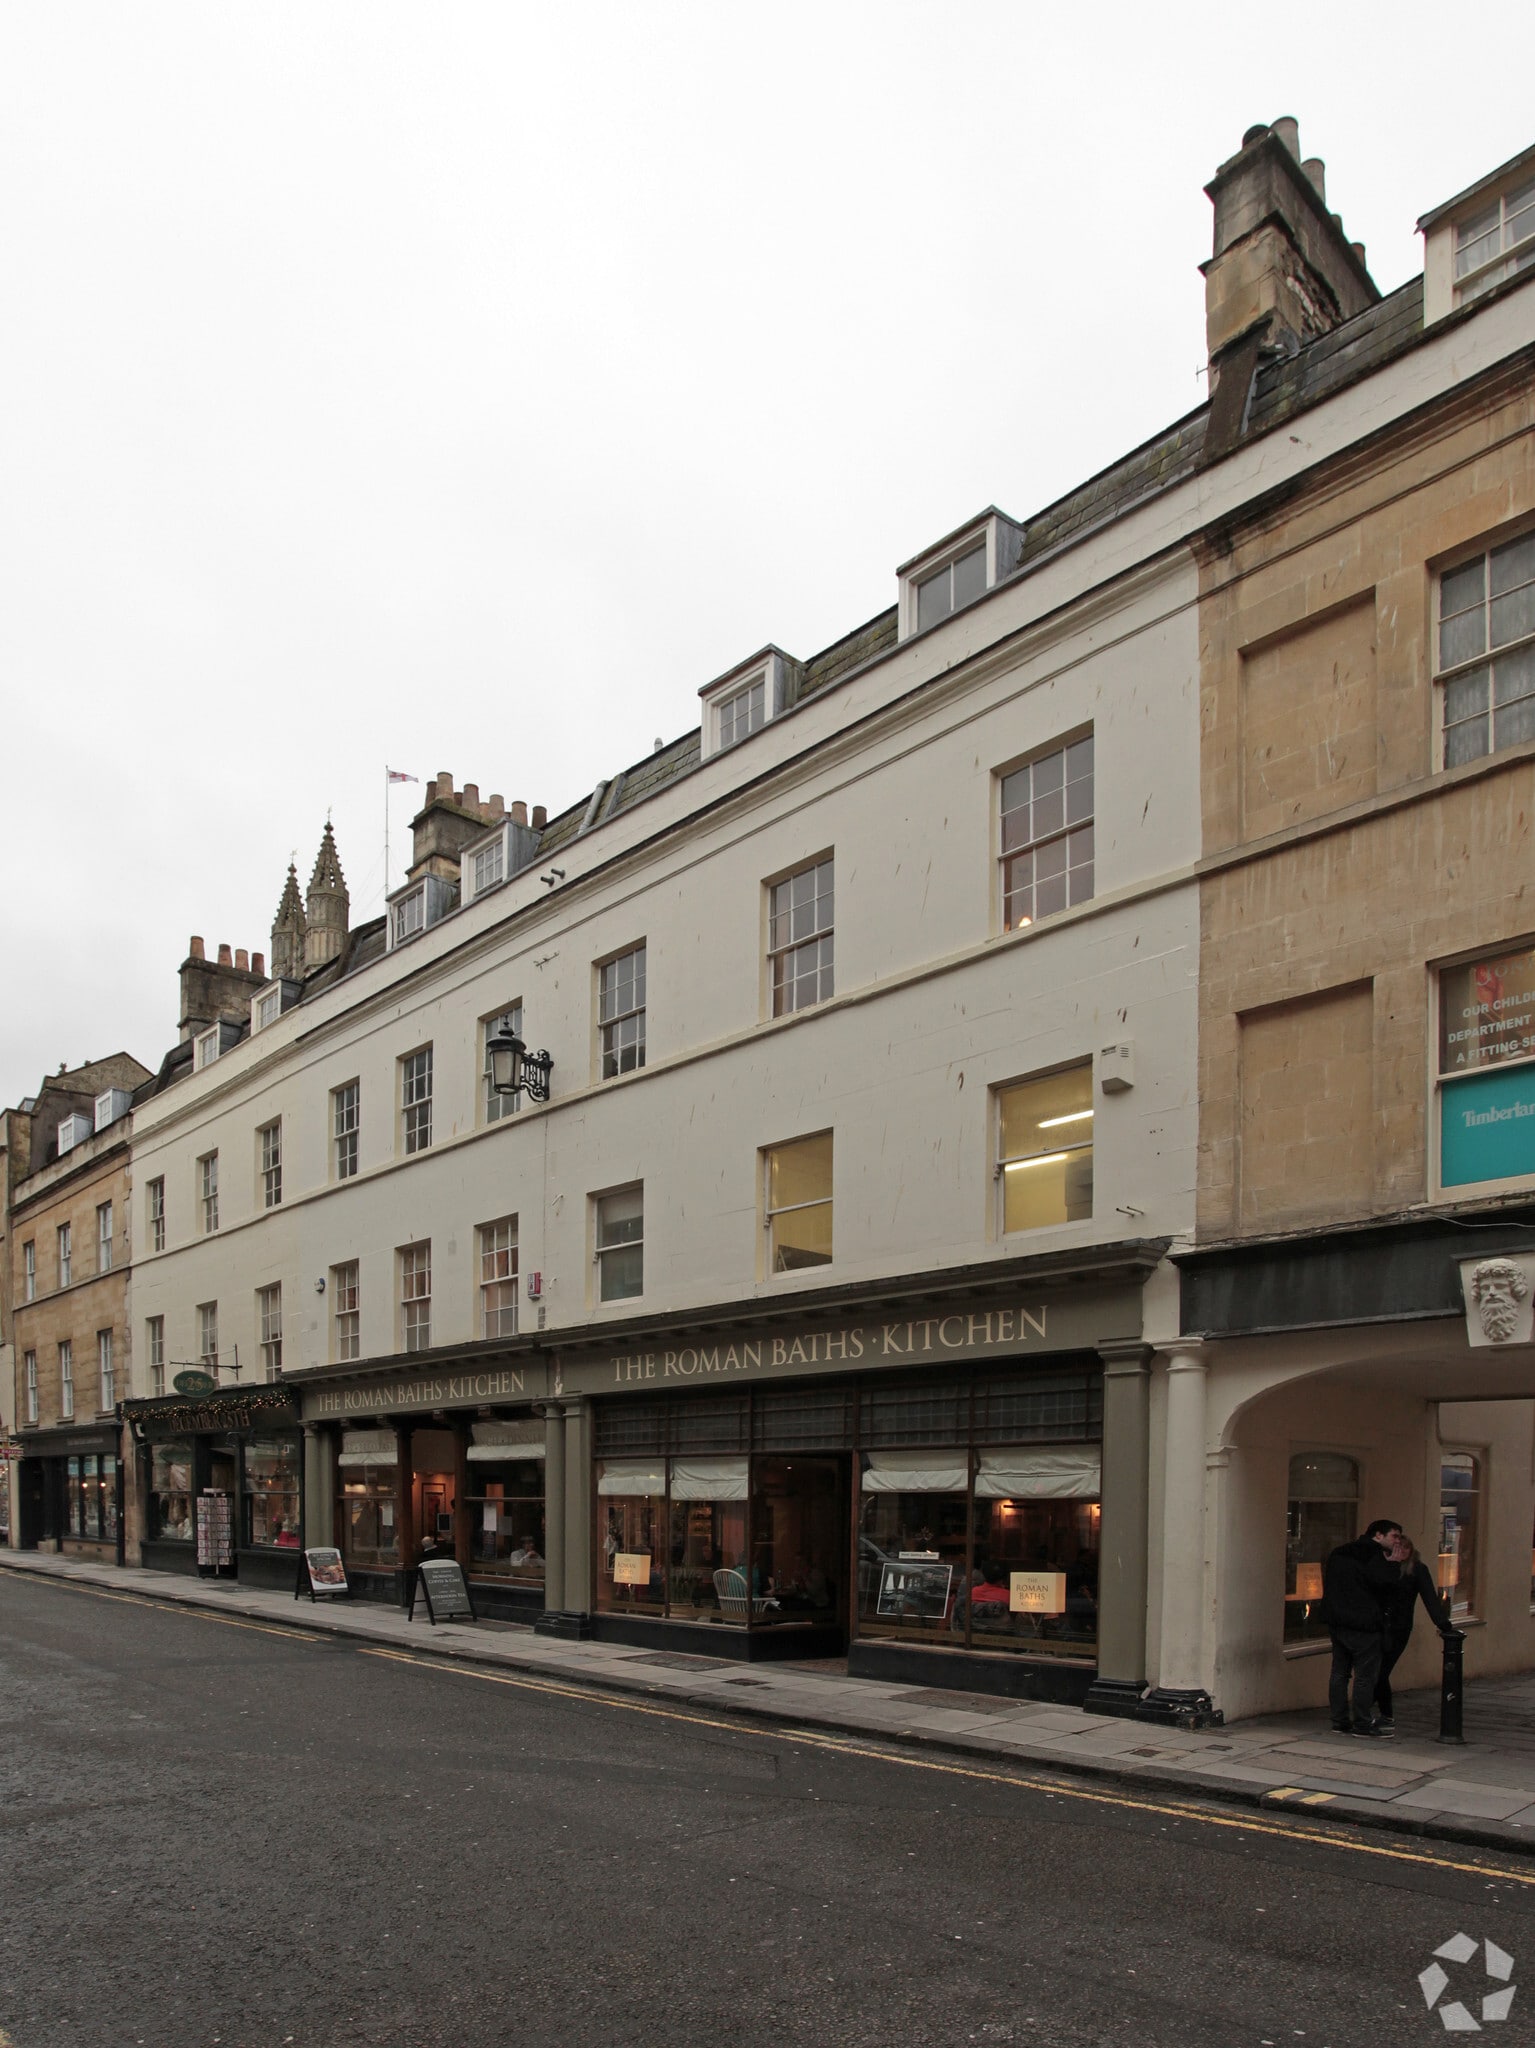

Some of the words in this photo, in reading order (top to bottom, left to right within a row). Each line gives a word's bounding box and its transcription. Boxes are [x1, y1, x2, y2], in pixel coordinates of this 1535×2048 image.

[1463, 1003, 1490, 1018] OUR
[1448, 1014, 1532, 1044] DEPARTMENT
[1456, 1052, 1466, 1064] A
[1468, 1039, 1519, 1061] FITTING
[611, 1354, 656, 1382] THE
[663, 1340, 762, 1378] ROMAN
[771, 1328, 864, 1367] BATHS
[881, 1305, 1048, 1355] KITCHEN
[317, 1392, 341, 1412] THE
[344, 1385, 395, 1410] ROMAN
[397, 1379, 442, 1405] BATHS
[449, 1369, 525, 1399] KITCHEN
[1016, 1584, 1049, 1592] ROMAN
[1019, 1592, 1046, 1601] BATHS
